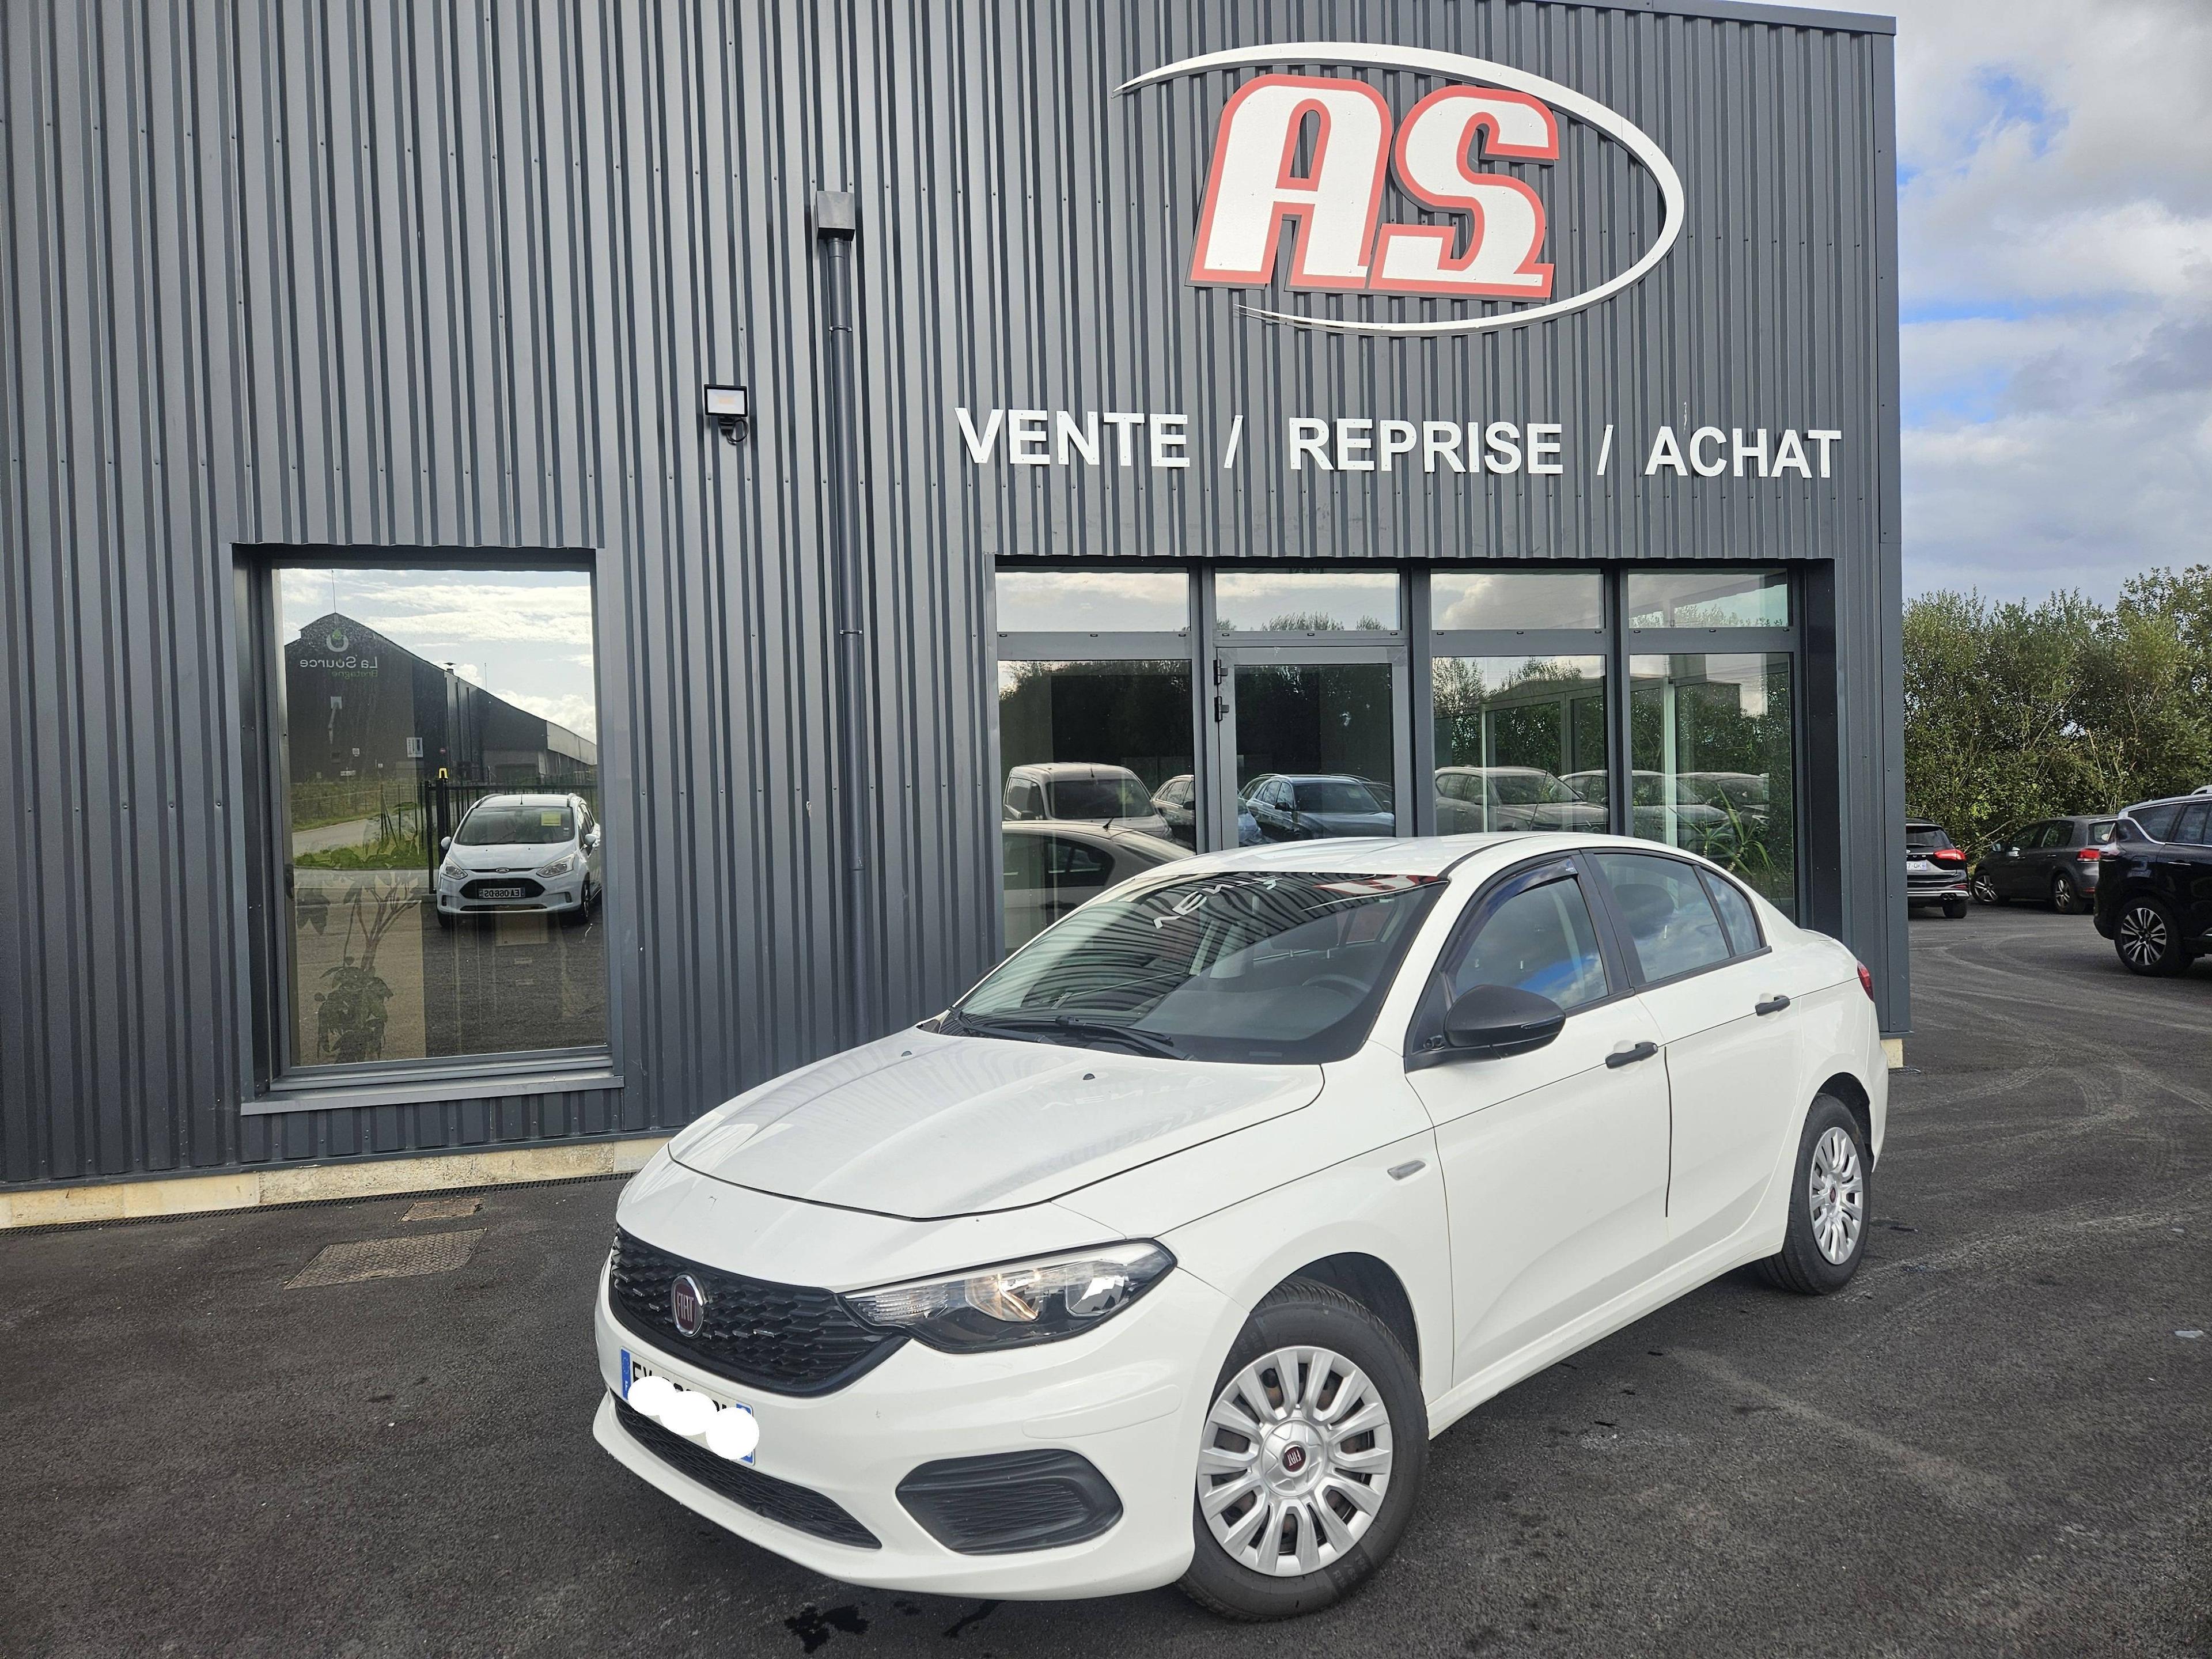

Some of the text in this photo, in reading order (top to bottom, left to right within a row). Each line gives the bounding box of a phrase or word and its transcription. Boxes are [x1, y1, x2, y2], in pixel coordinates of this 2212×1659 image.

[1191, 73, 1559, 297] AS
[954, 407, 1842, 479] VENTE / REPRISE / ACHAT
[676, 1291, 694, 1322] FIAT
[1287, 1449, 1301, 1467] FIAT
